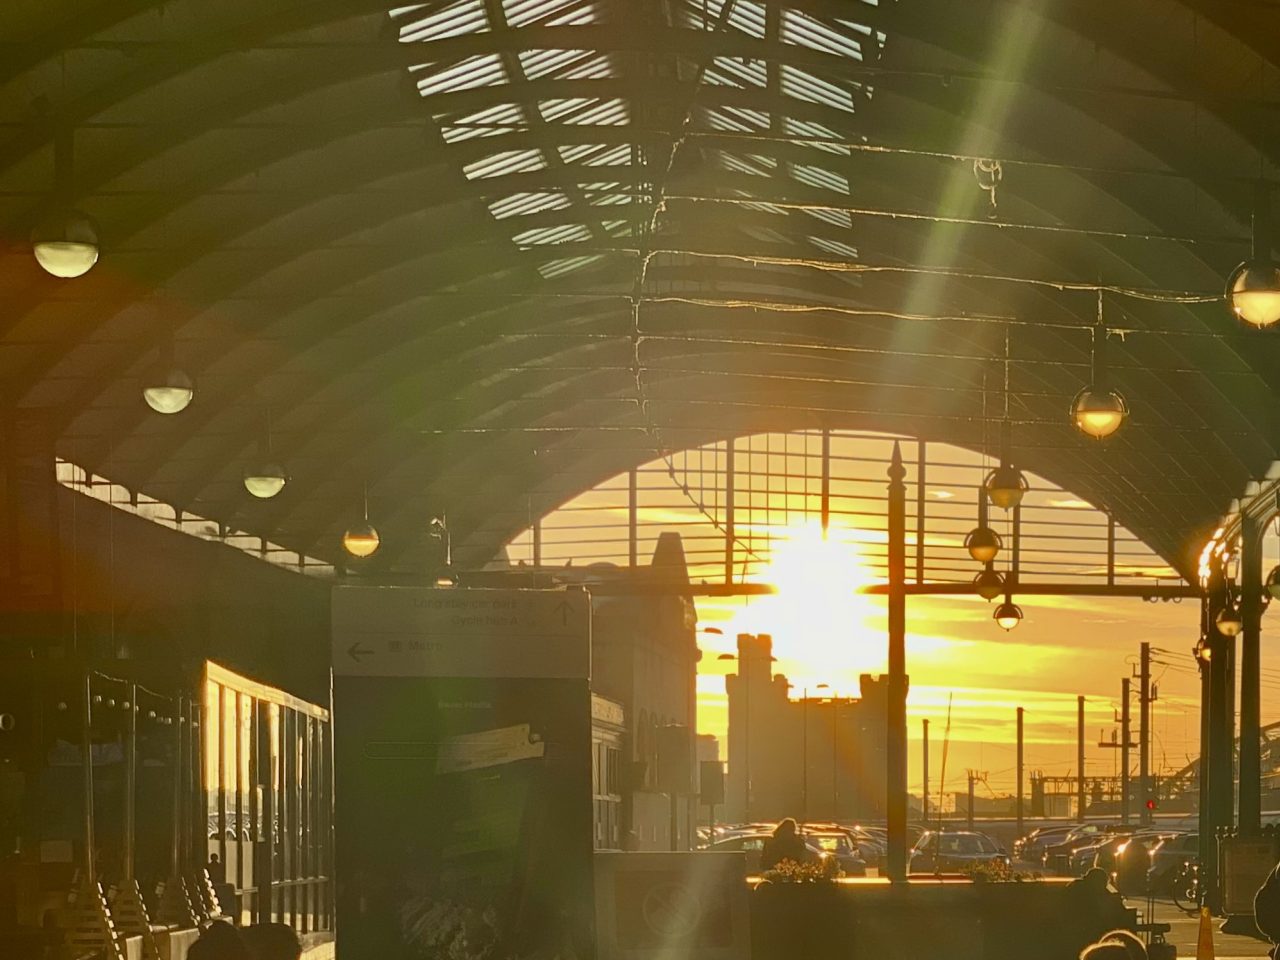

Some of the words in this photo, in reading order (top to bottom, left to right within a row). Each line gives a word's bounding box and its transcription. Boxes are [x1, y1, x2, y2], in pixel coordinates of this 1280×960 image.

[413, 597, 442, 610] Long
[450, 615, 483, 627] Cycle
[408, 639, 443, 651] Metro
